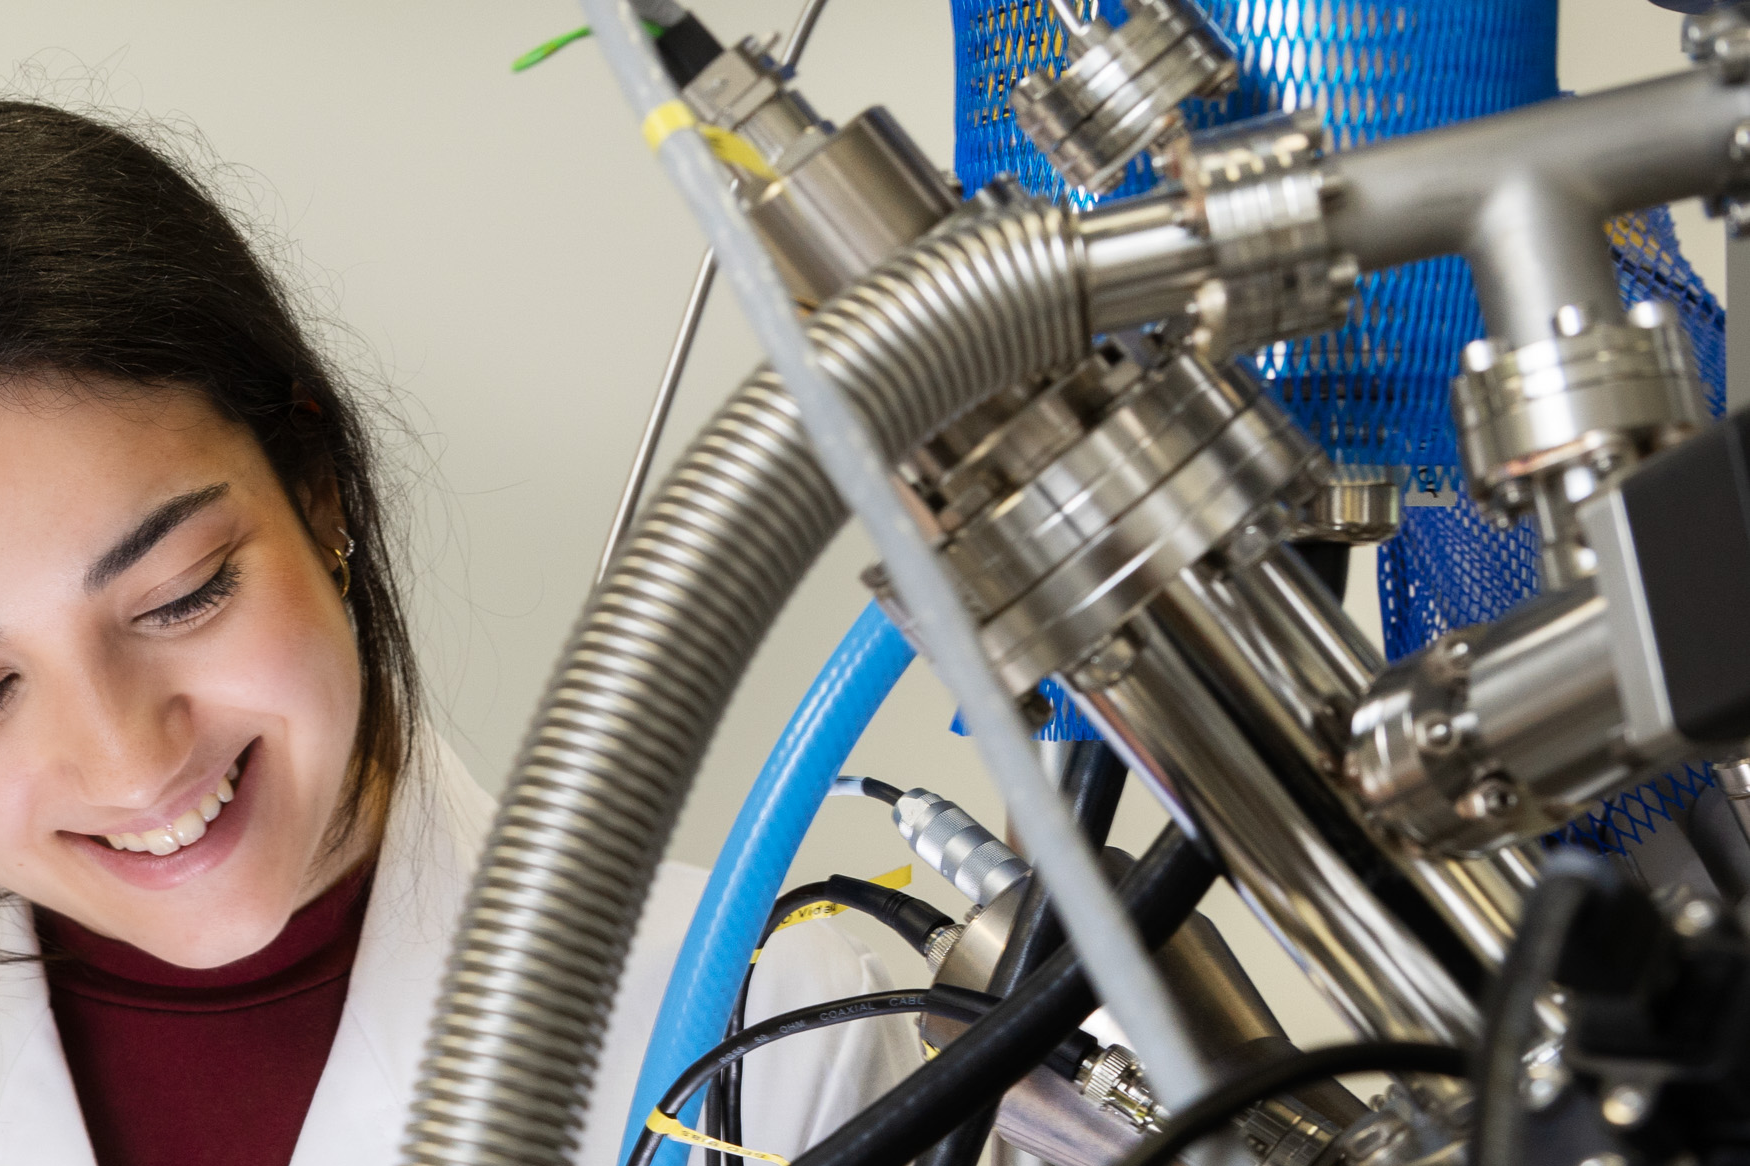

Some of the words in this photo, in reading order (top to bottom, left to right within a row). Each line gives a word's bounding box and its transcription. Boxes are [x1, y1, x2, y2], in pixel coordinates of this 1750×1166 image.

[778, 1019, 807, 1036] OHM
[818, 1001, 876, 1022] COAXIAL
[888, 997, 927, 1008] CABL
